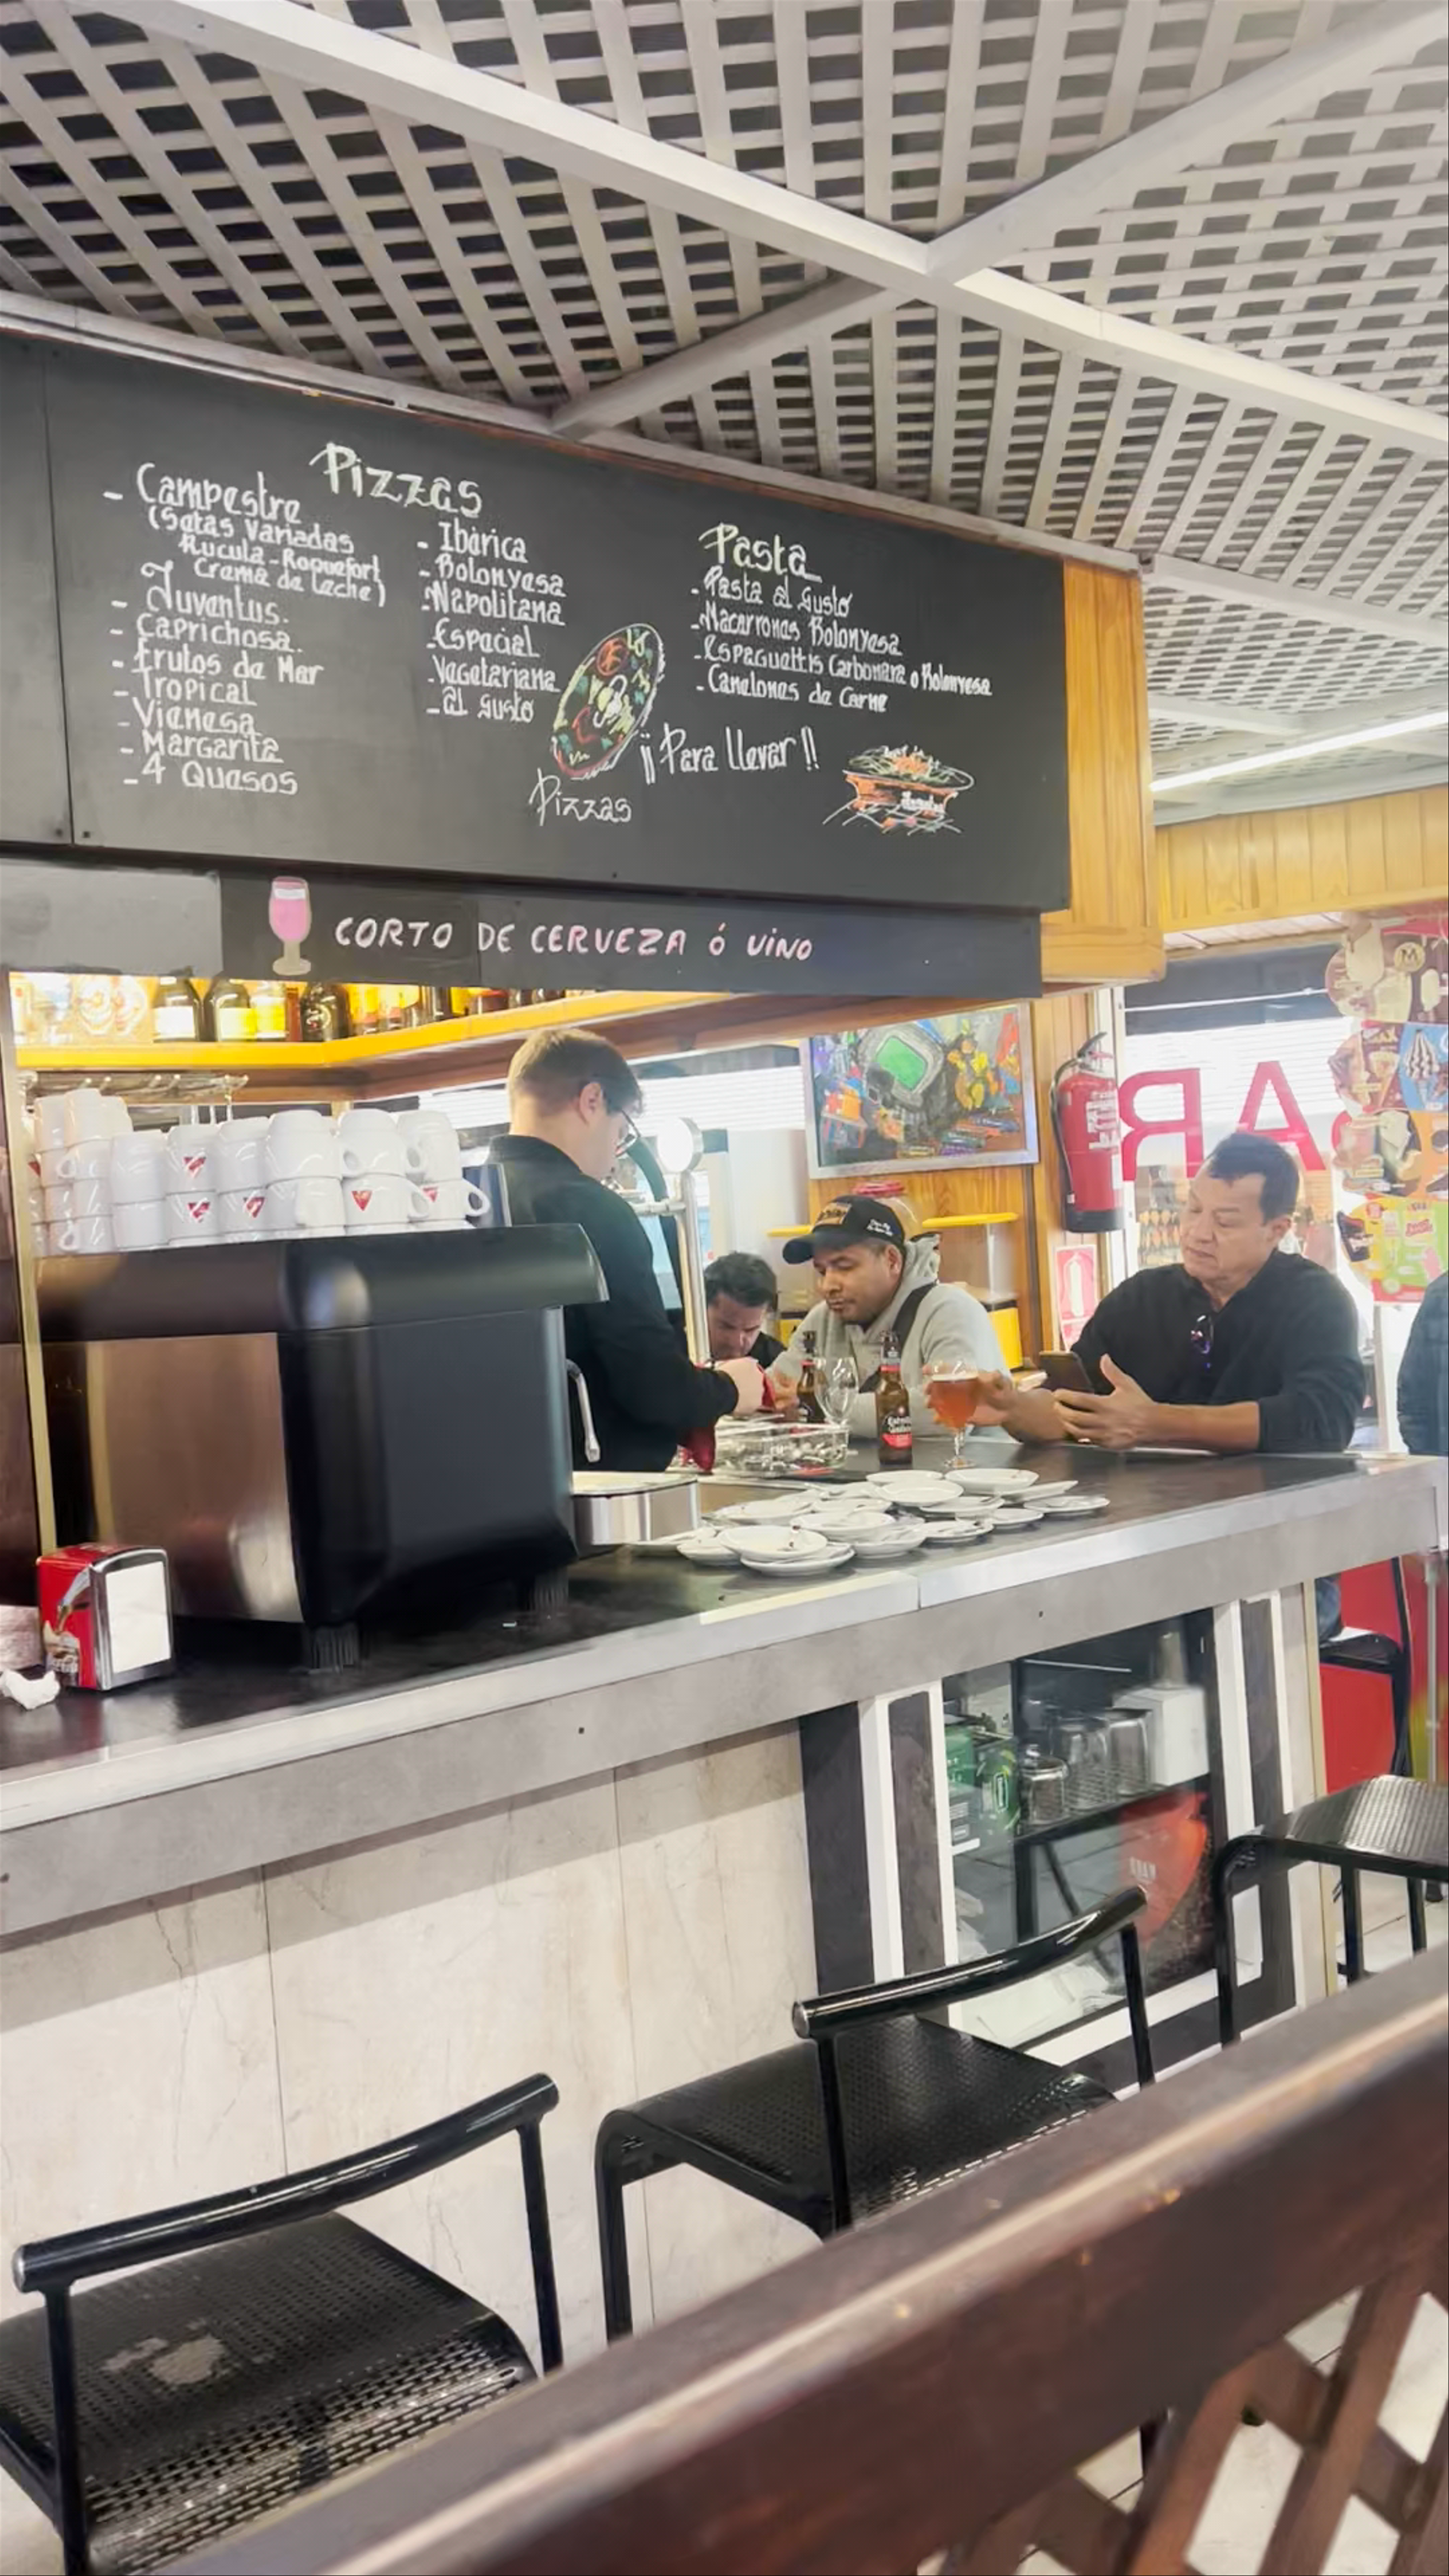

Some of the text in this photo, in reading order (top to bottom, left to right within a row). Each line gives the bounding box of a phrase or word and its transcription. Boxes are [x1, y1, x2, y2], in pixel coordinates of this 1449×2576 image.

[136, 462, 302, 524] Campestre
[308, 441, 483, 518] Pizzas
[435, 552, 567, 597] Bolonyesa
[698, 523, 823, 584] Pasta
[424, 580, 566, 626] Napolitana
[703, 564, 764, 605] Pasta
[432, 617, 541, 658] Especial
[808, 615, 903, 656] Bolonyesa
[131, 666, 258, 707] Tropical
[233, 649, 266, 680] de
[277, 654, 325, 685] Mar
[707, 663, 889, 713] Canelones de Carne
[142, 754, 298, 795] 4 Quesos
[528, 767, 632, 827] Pizzas
[334, 916, 453, 949] CORTO
[477, 921, 515, 953] DE
[530, 925, 688, 956] CERVEZA
